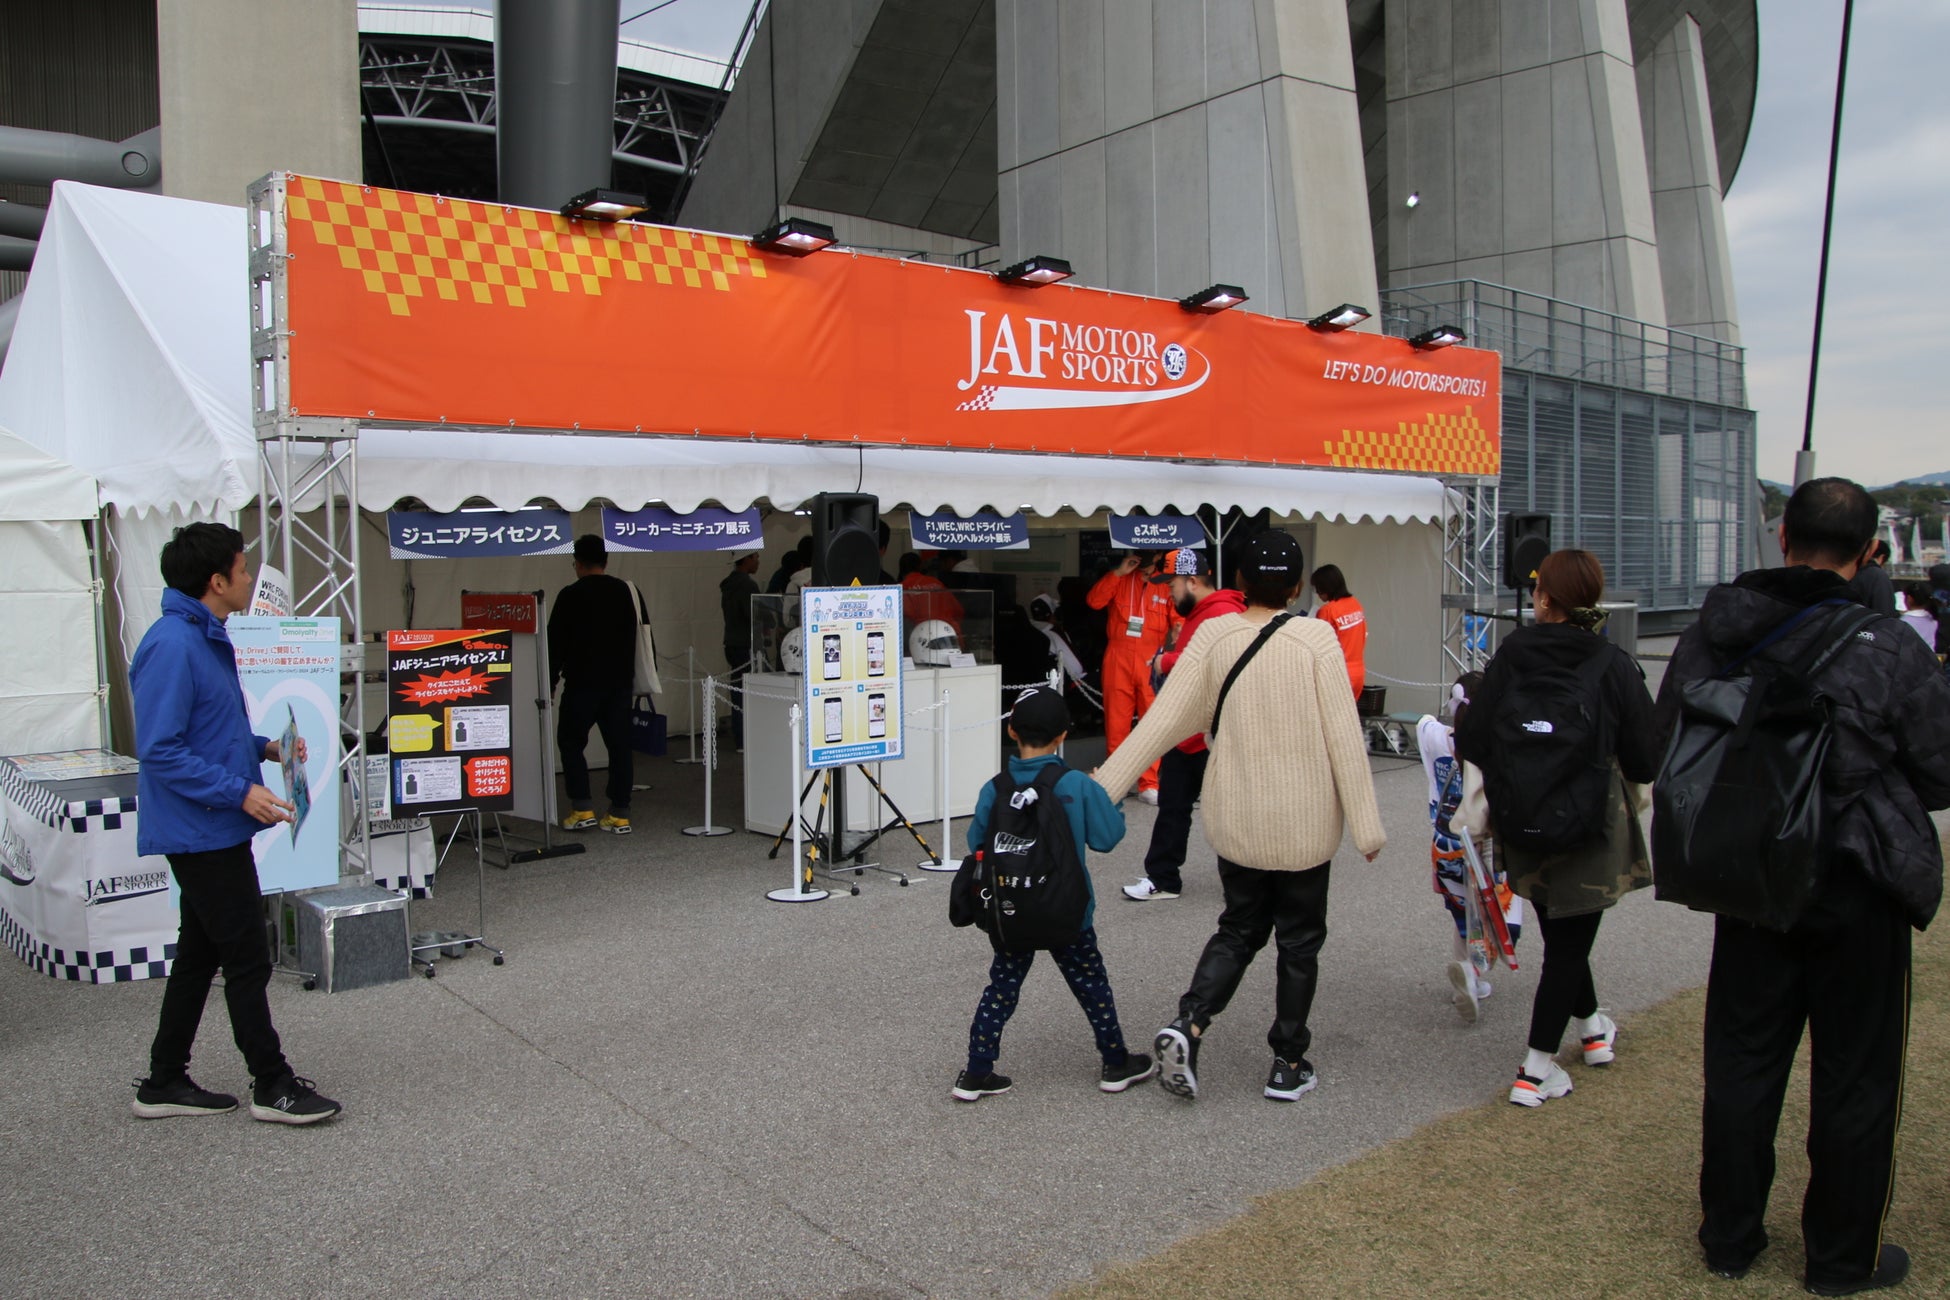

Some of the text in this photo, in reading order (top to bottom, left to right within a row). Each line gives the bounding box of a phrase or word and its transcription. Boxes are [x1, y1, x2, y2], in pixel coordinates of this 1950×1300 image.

[957, 309, 1159, 391] JAF MOTOR
[1061, 351, 1158, 387] SPORTS
[1323, 360, 1360, 382] LET'S
[1362, 365, 1387, 385] DO
[401, 524, 562, 546] ジュニアライセンス
[615, 521, 751, 536] ラリーカーミニチュア展示
[1134, 523, 1178, 536] eスポーツ
[928, 532, 1012, 544] サイン入りヘルメット展示
[393, 634, 413, 644] JAF
[392, 650, 505, 671] JAFジュニアライセンス！
[427, 678, 471, 689] クイズにこたえて
[475, 758, 508, 768] きみだけの
[475, 768, 506, 776] オリジナル
[475, 777, 507, 785] ライセンス
[85, 871, 167, 902] JAF MOTOR
[124, 879, 167, 891] SPORTS
